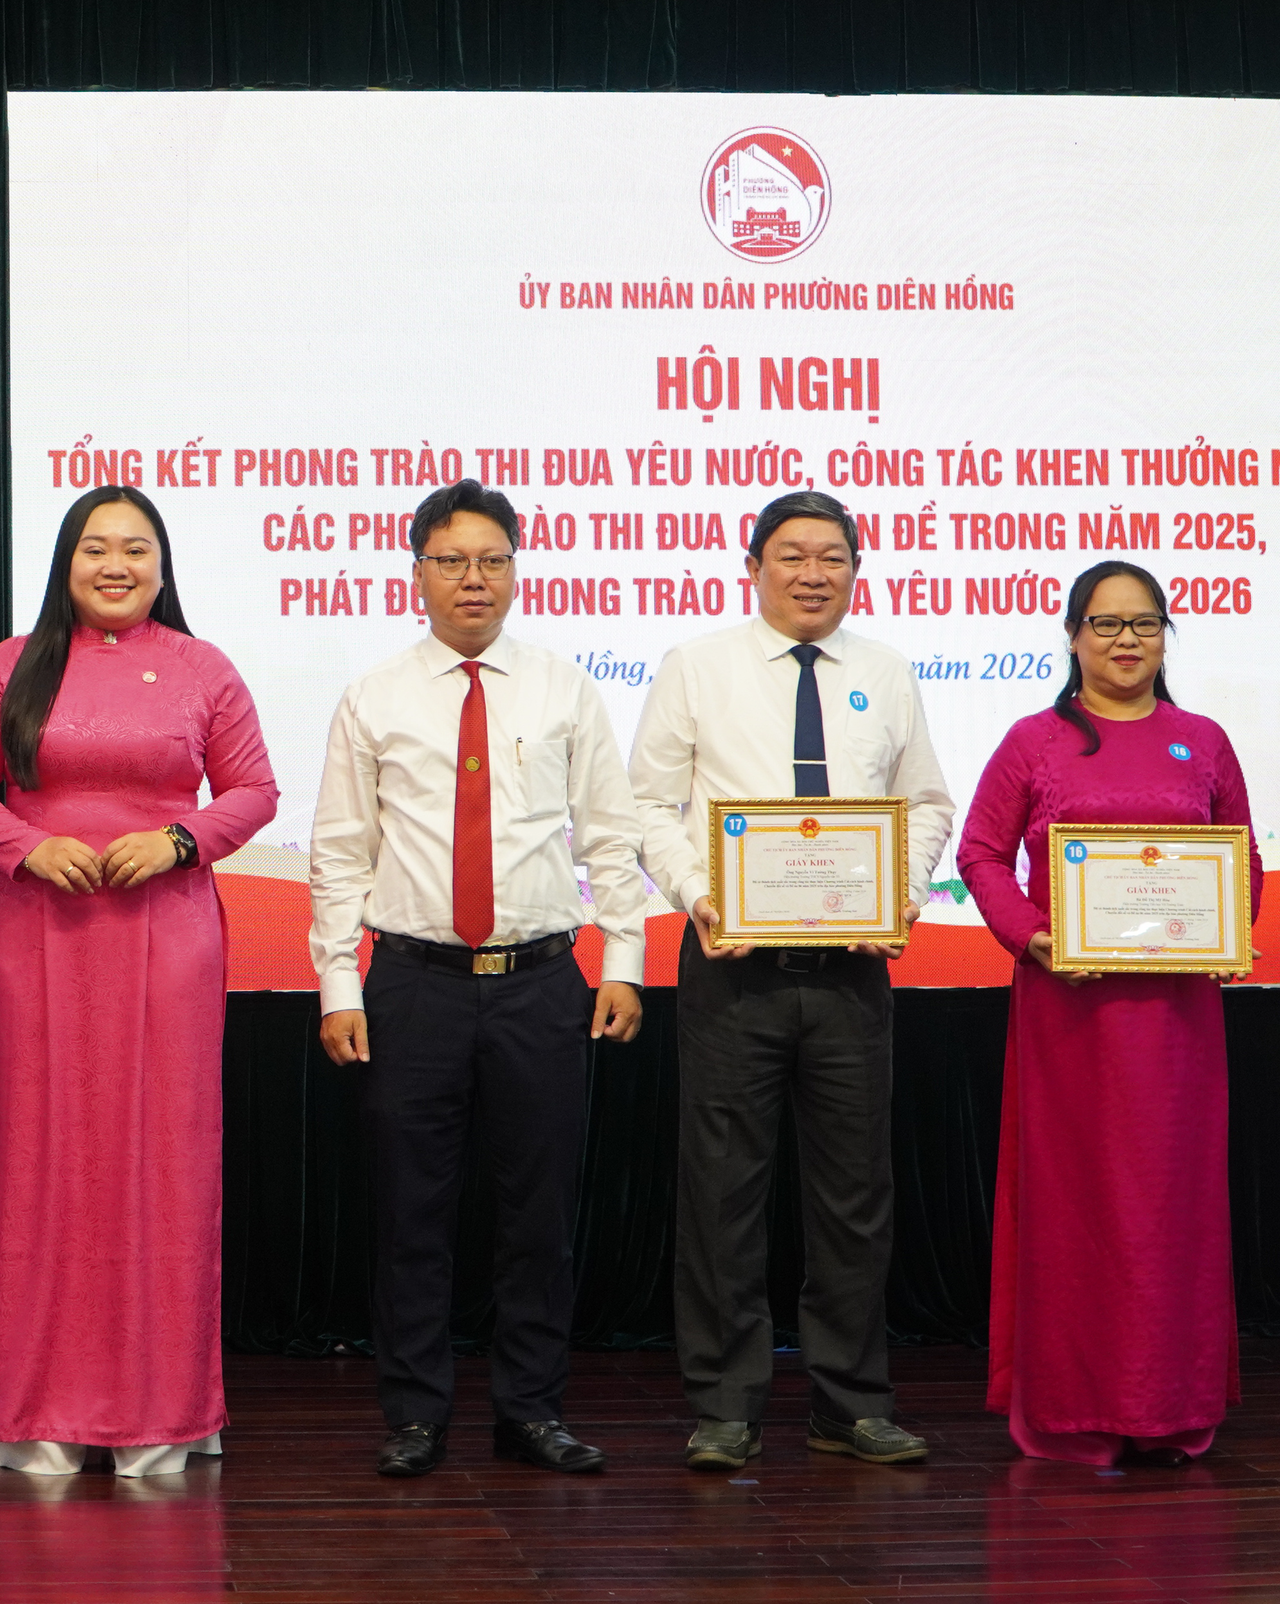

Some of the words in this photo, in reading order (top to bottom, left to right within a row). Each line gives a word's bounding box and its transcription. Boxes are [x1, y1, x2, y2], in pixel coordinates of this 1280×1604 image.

[519, 273, 551, 310] ỦY
[560, 282, 613, 309] BAN
[622, 277, 694, 309] NHÂN
[703, 277, 756, 310] DÂN
[764, 278, 869, 311] PHƯỜNG
[876, 278, 936, 311] DIÊN
[945, 274, 1014, 311] HỒNG
[657, 344, 740, 423] HỘI
[759, 356, 880, 424] NGHỊ
[48, 434, 143, 488] TỔNG
[156, 437, 222, 488] KẾT
[234, 448, 359, 487] PHONG
[370, 441, 463, 487] TRÀO
[475, 448, 530, 486] THI
[542, 448, 614, 487] ĐUA
[626, 441, 692, 487] YÊU
[706, 441, 814, 490] NƯỚC,
[827, 441, 925, 488] CÔNG
[936, 440, 1003, 487] TÁC
[1015, 448, 1110, 487] KHEN
[1121, 435, 1260, 487] THƯỞNG
[263, 506, 336, 552] CÁC
[588, 512, 644, 551] THI
[655, 512, 728, 551] ĐUA
[892, 500, 938, 551] ĐỀ
[949, 512, 1067, 551] TRONG
[1078, 505, 1161, 551] NĂM
[1173, 512, 1267, 555] 2025,
[280, 570, 373, 617] PHÁT
[516, 577, 621, 617] HONG
[633, 569, 725, 616] TRÀO
[886, 569, 953, 616] YÊU
[965, 568, 1062, 616] NƯỚC
[1169, 576, 1253, 615] 2026
[911, 654, 971, 682] năm
[979, 653, 1053, 682] 2026
[852, 695, 864, 706] 17
[728, 818, 743, 831] 17
[786, 858, 808, 866] GIẤY
[1069, 845, 1083, 858] 16
[1127, 886, 1149, 894] GIẤY
